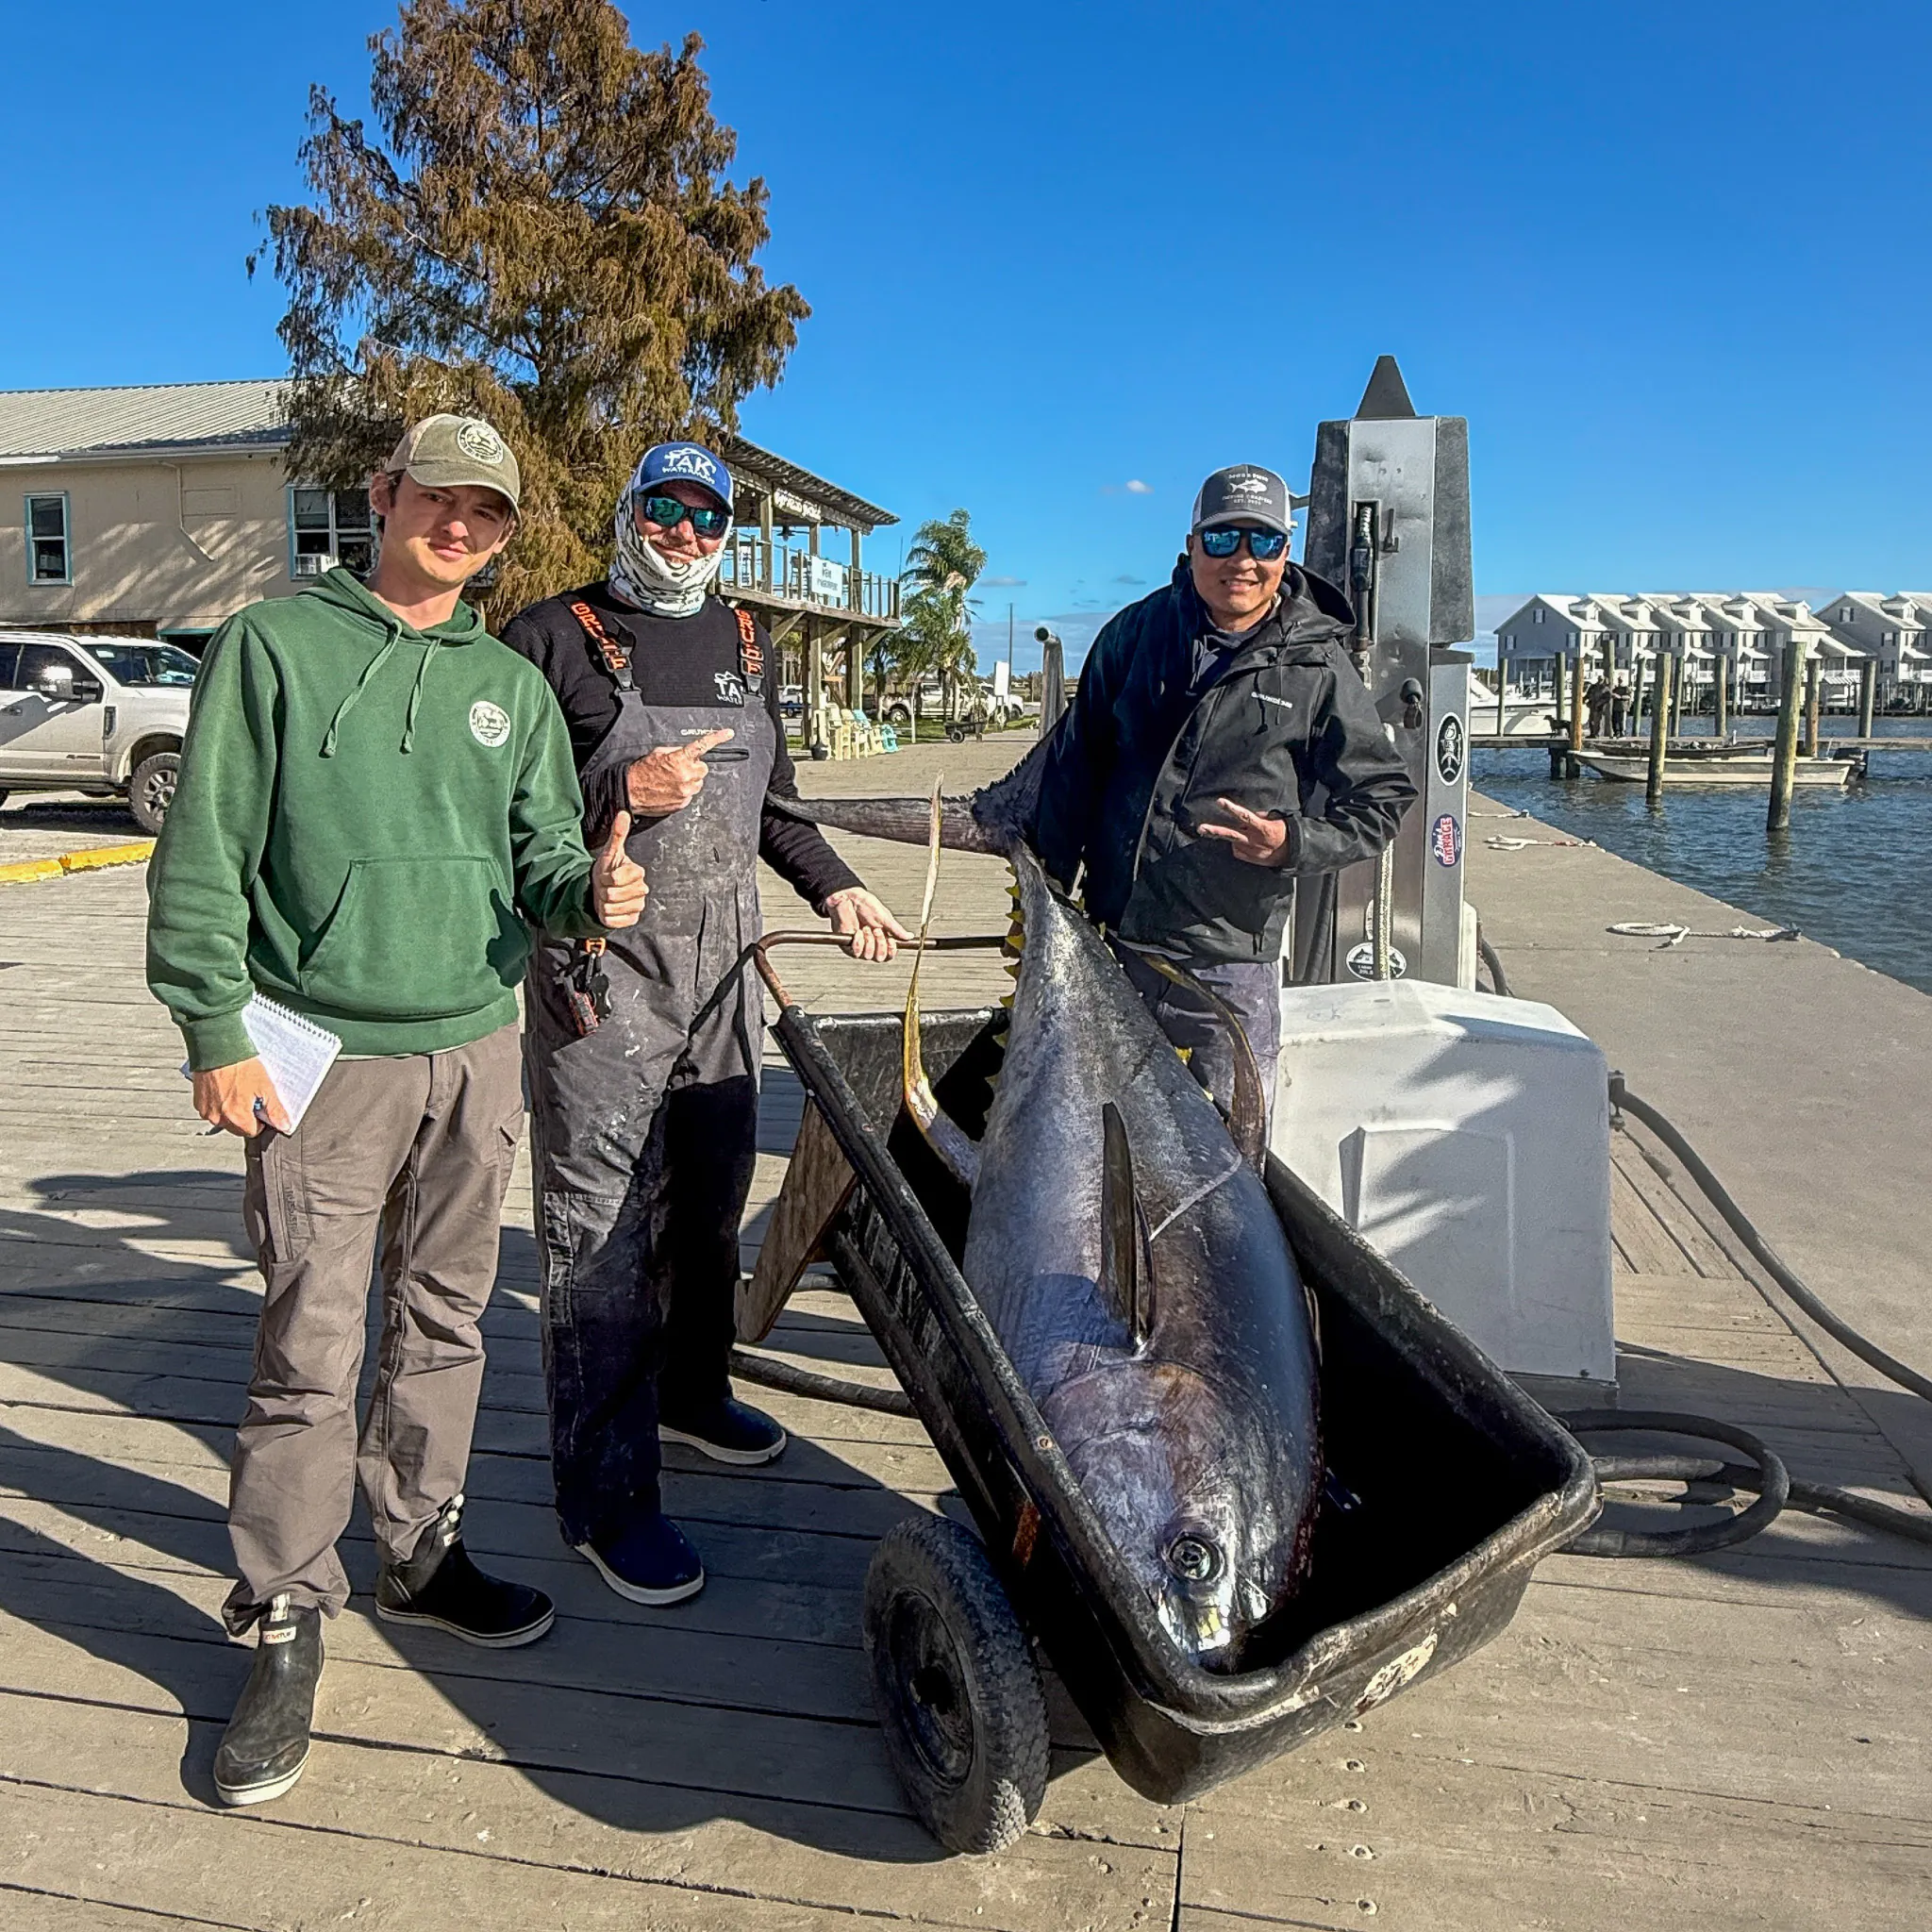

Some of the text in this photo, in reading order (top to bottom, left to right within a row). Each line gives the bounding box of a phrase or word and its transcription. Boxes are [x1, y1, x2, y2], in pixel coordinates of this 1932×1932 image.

[664, 454, 711, 476] TAK
[714, 678, 743, 698] TA
[1441, 818, 1454, 863] GARAGE
